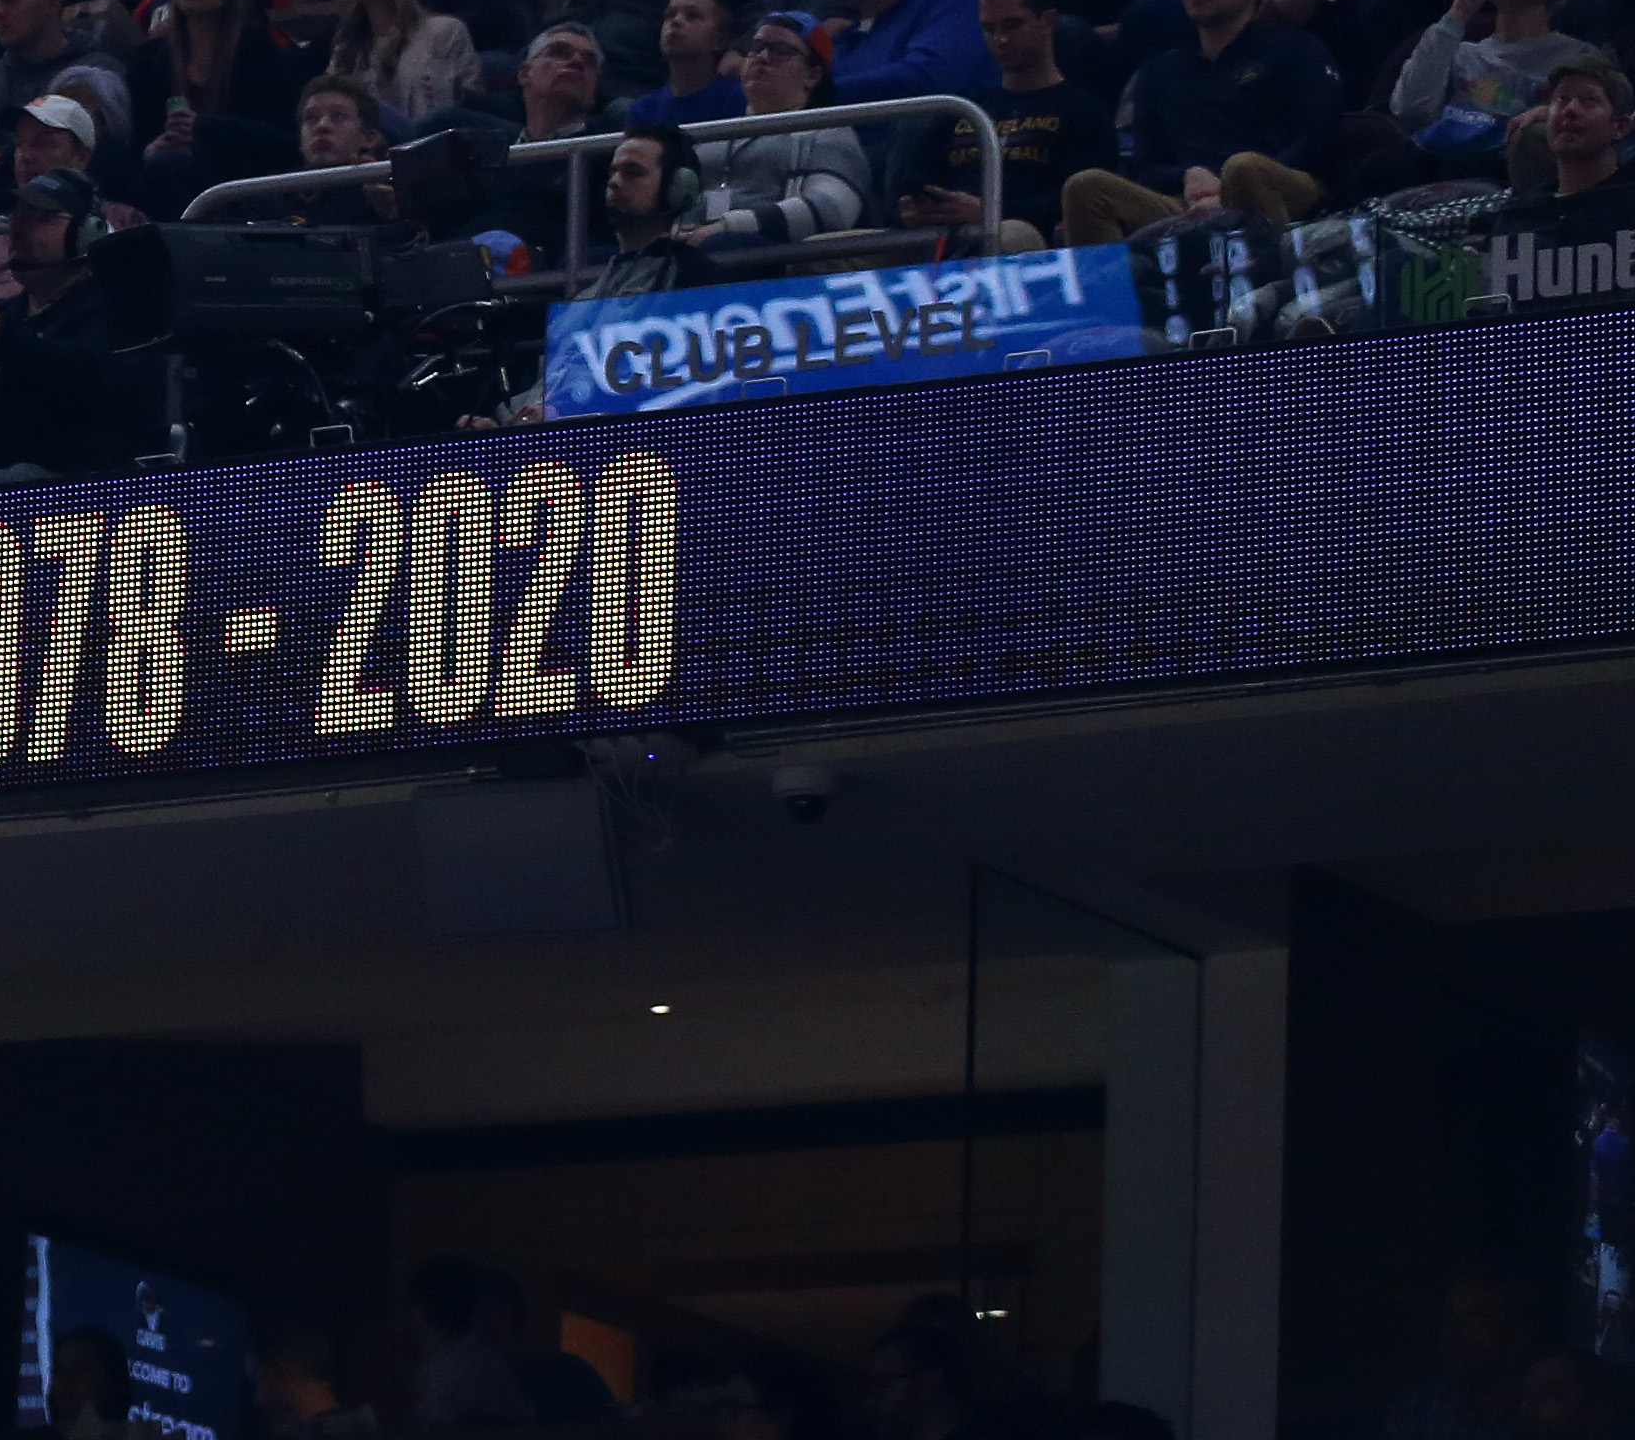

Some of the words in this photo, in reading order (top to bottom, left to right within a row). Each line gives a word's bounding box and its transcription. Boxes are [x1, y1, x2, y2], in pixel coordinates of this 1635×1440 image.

[605, 325, 773, 394] CLUB
[795, 299, 998, 372] LEVEL
[223, 604, 280, 655] -
[313, 449, 679, 736] 2020
